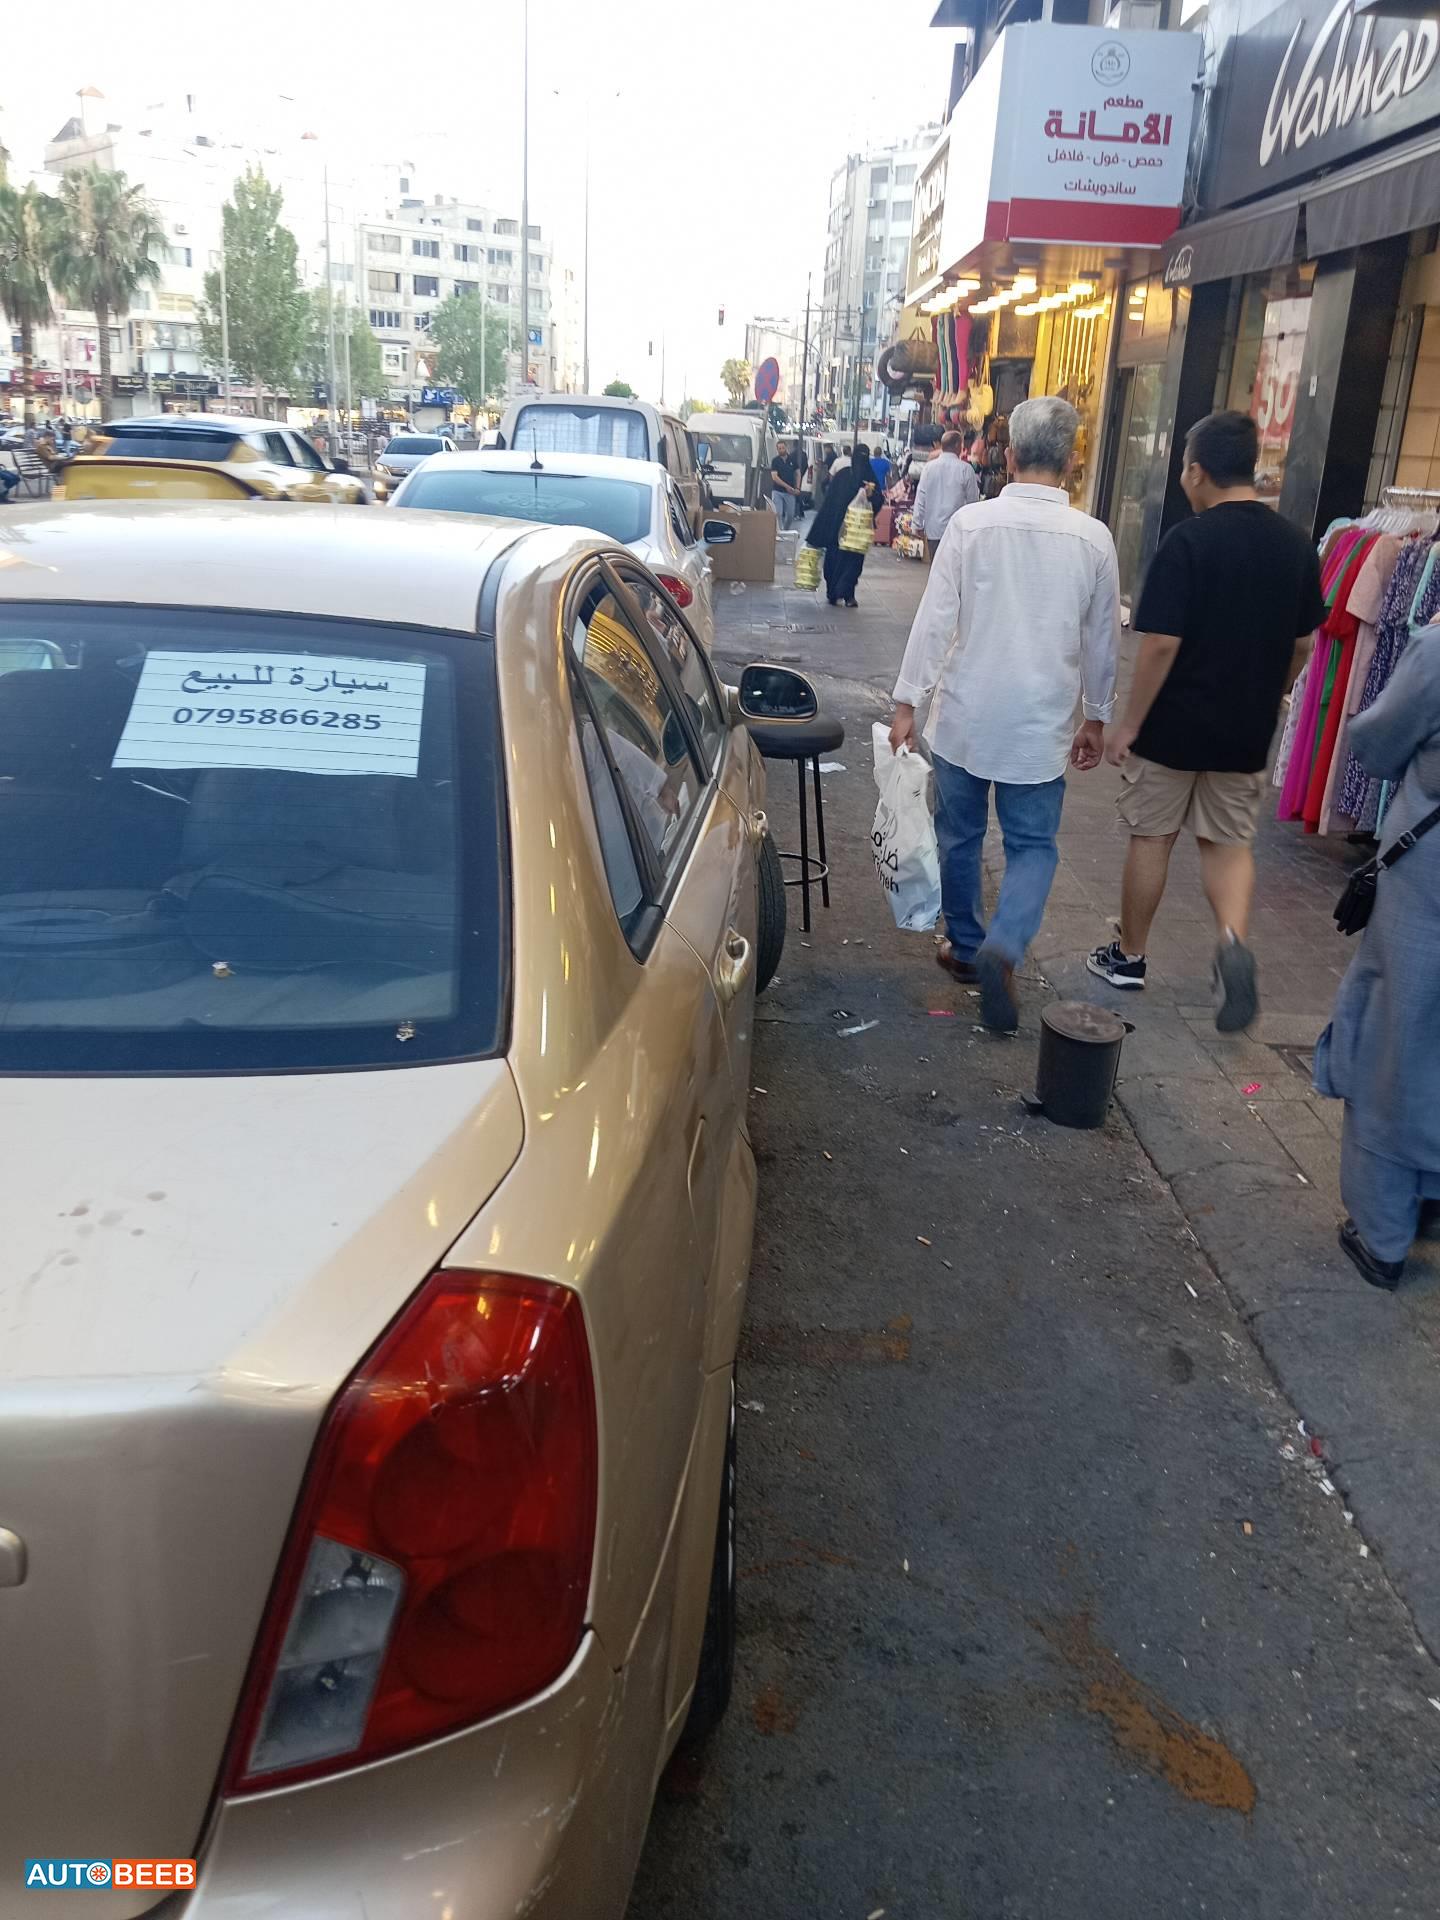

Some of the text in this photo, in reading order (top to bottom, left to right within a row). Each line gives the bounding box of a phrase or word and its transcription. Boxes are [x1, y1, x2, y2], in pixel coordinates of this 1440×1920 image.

[1104, 94, 1144, 111] مطعم
[1047, 149, 1084, 163] فلافل
[1093, 152, 1119, 167] فول
[1128, 154, 1163, 168] حمص
[1064, 178, 1136, 195] ساندويشات
[181, 665, 389, 694] سيارة للبيع
[173, 708, 381, 730] 0795866285
